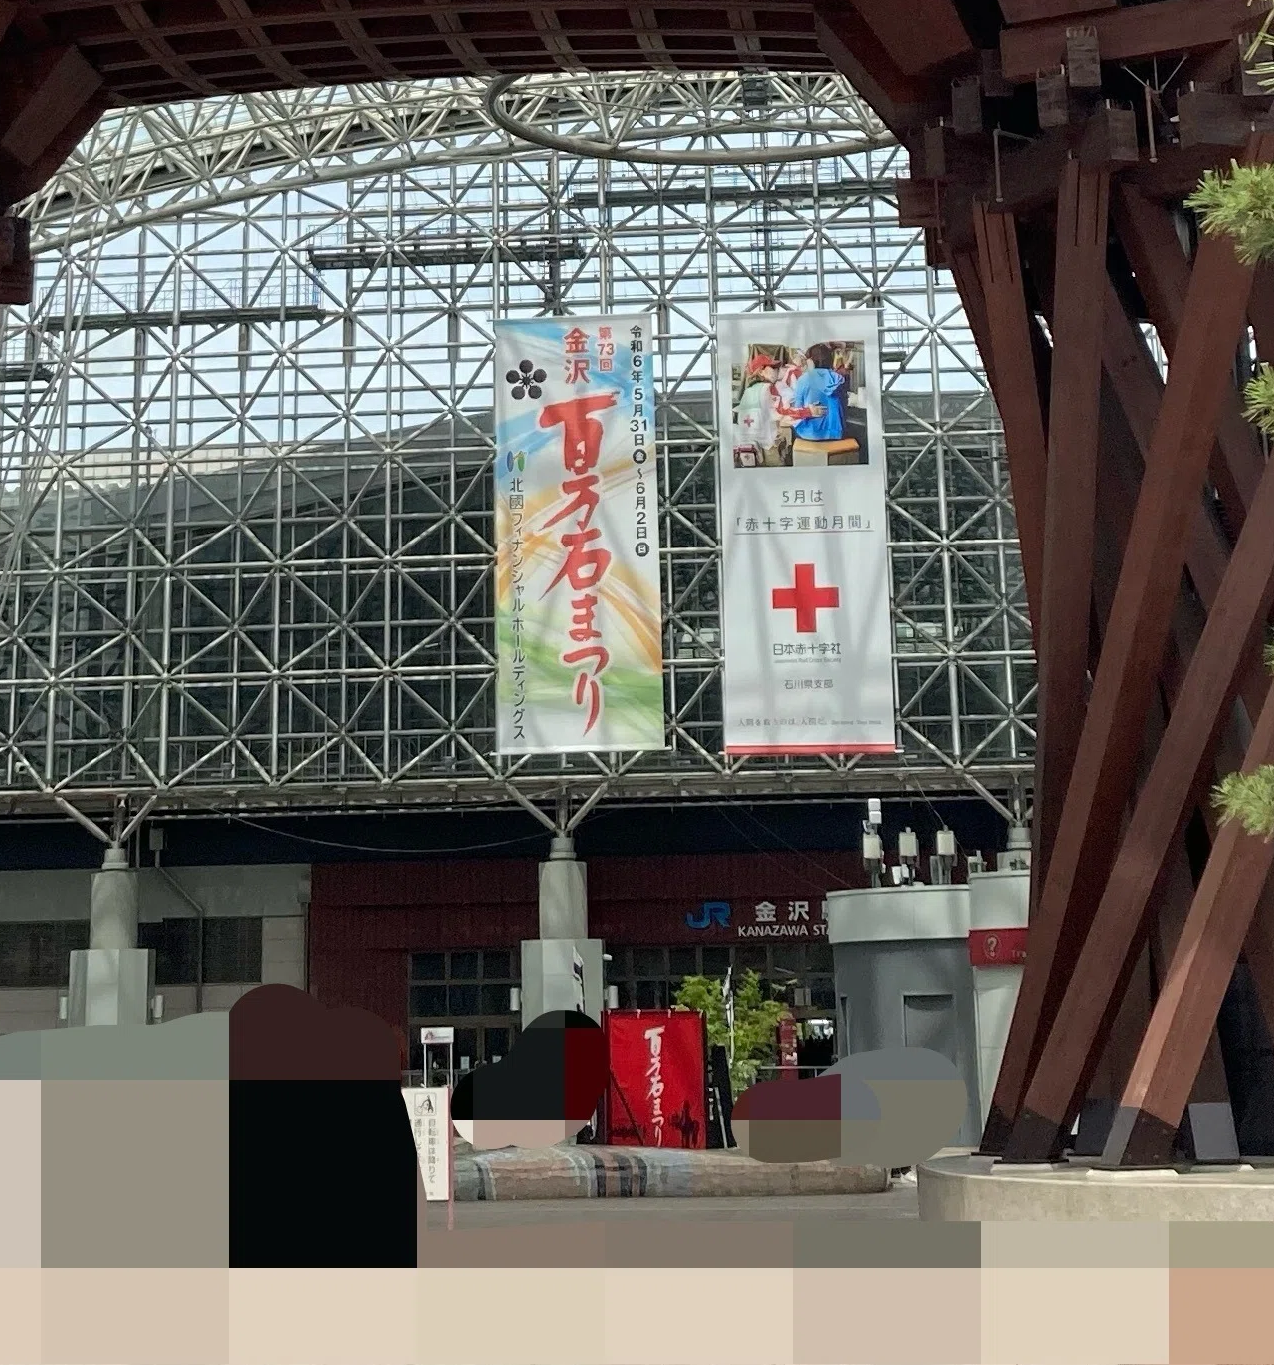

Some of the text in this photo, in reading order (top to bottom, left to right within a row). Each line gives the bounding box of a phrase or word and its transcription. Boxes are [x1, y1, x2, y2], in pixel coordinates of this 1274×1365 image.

[563, 327, 591, 384] 金沢
[597, 326, 615, 372] 第73回
[782, 489, 823, 504] 5月は
[736, 514, 871, 532] 「赤十字運動月間」
[537, 390, 620, 737] 百万石まつり
[773, 643, 841, 655] 日本赤十字社
[684, 901, 731, 929] JR
[738, 924, 808, 937] KANAZAWA
